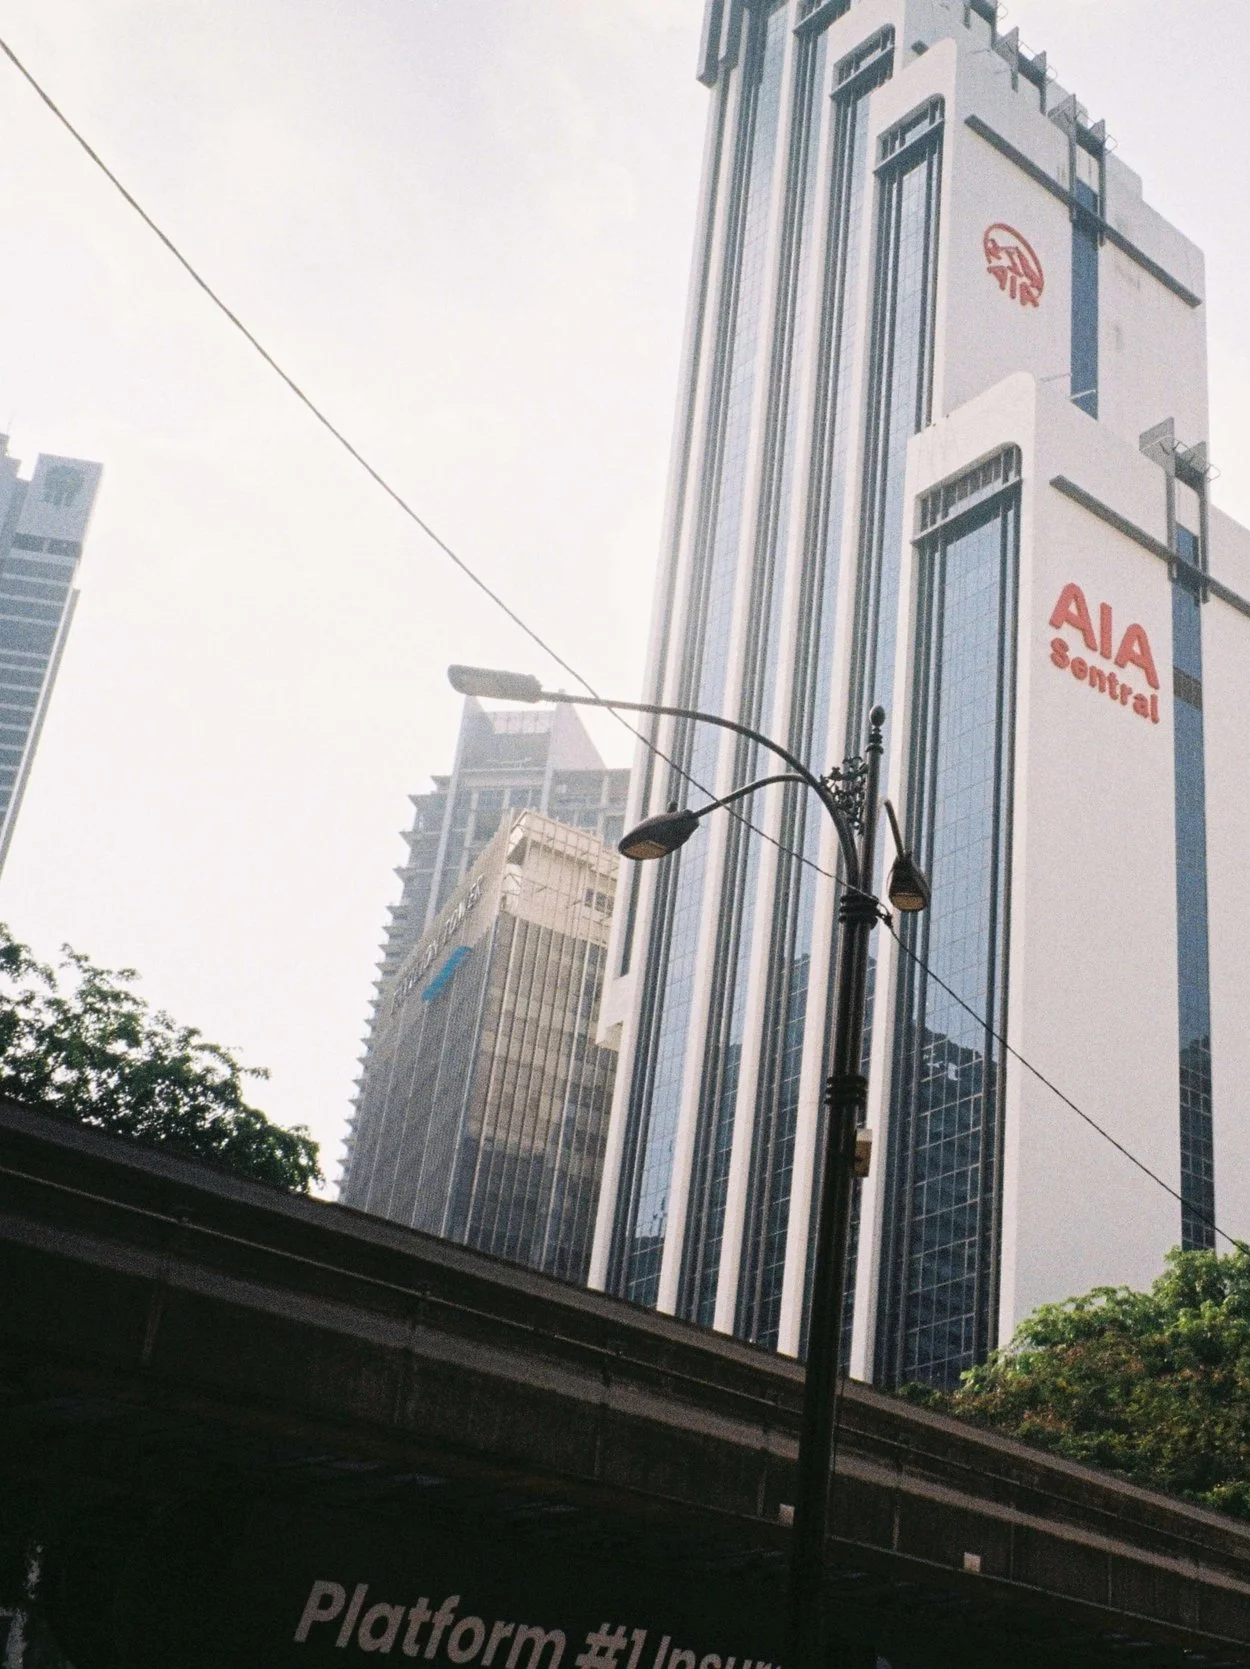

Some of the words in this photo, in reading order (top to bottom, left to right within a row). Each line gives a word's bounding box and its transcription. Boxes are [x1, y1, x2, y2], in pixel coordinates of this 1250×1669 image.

[1049, 583, 1160, 690] AIA
[1051, 637, 1160, 724] Sentral
[294, 1580, 567, 1669] Platform
[575, 1622, 648, 1669] #1
